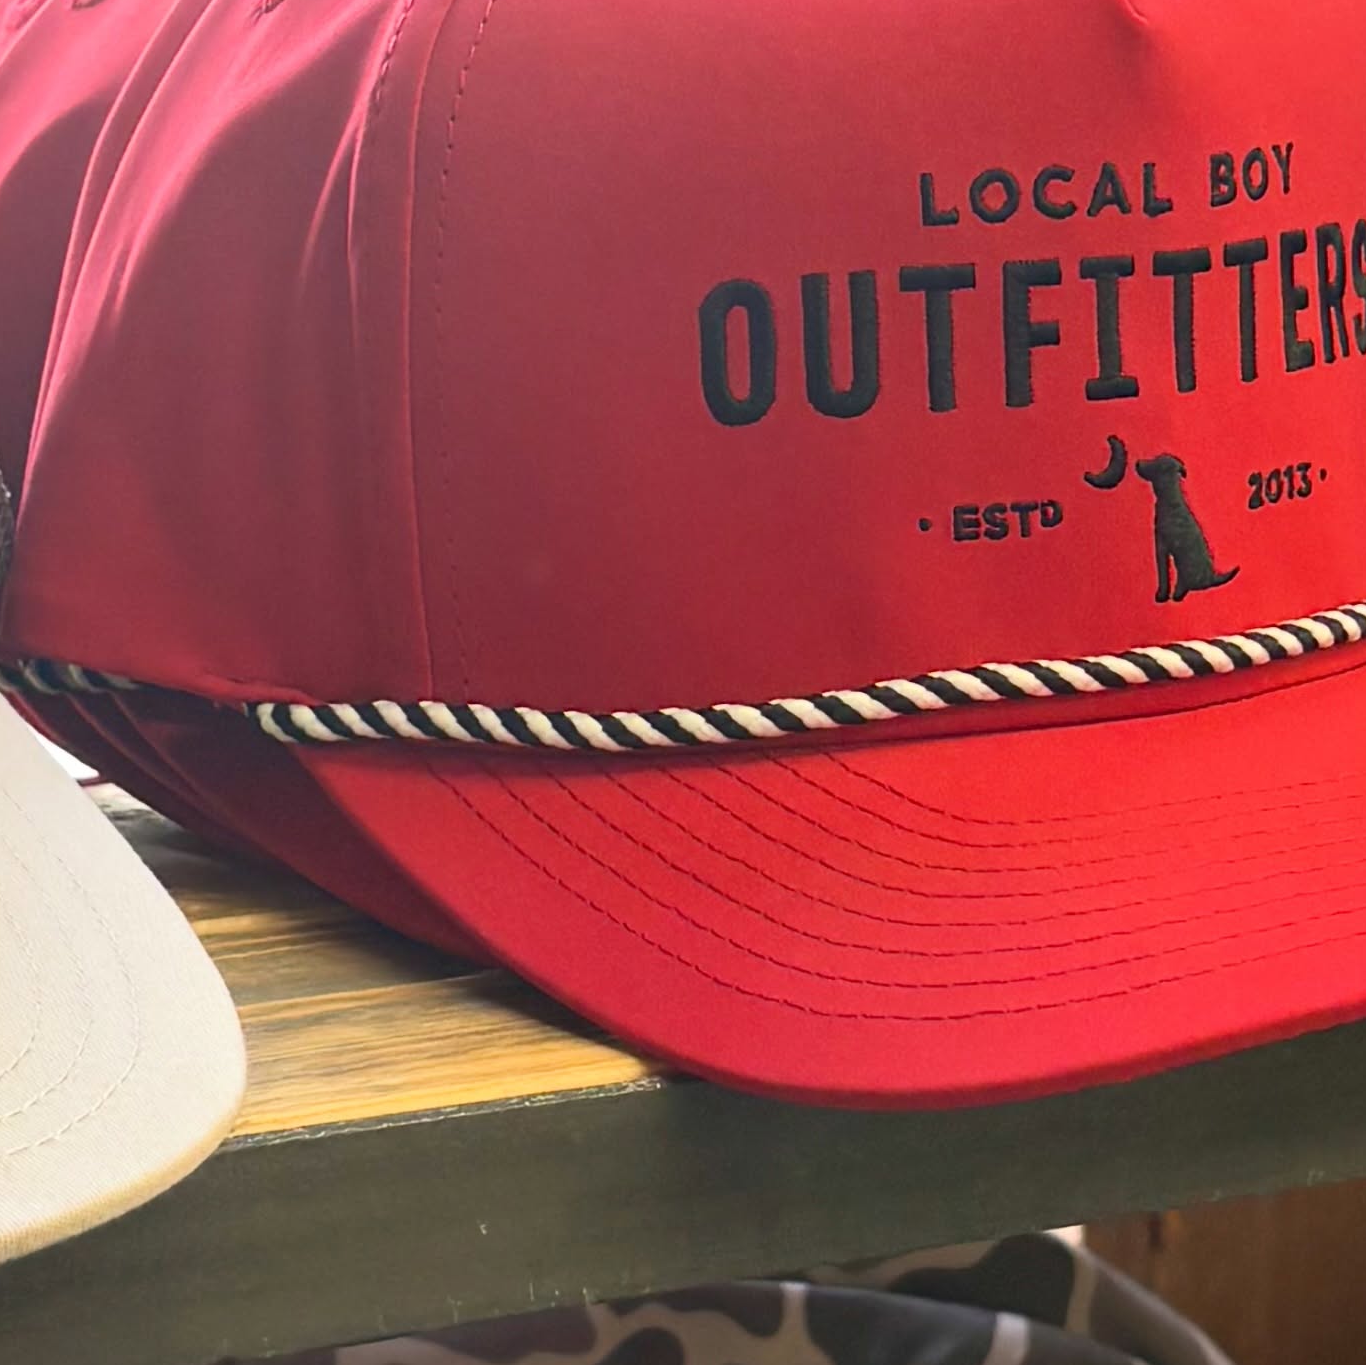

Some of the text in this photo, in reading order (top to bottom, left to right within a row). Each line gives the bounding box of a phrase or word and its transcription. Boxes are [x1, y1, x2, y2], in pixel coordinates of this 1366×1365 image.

[919, 142, 1295, 228] LOCAL BOY
[952, 462, 1313, 542] ESTD 2013
